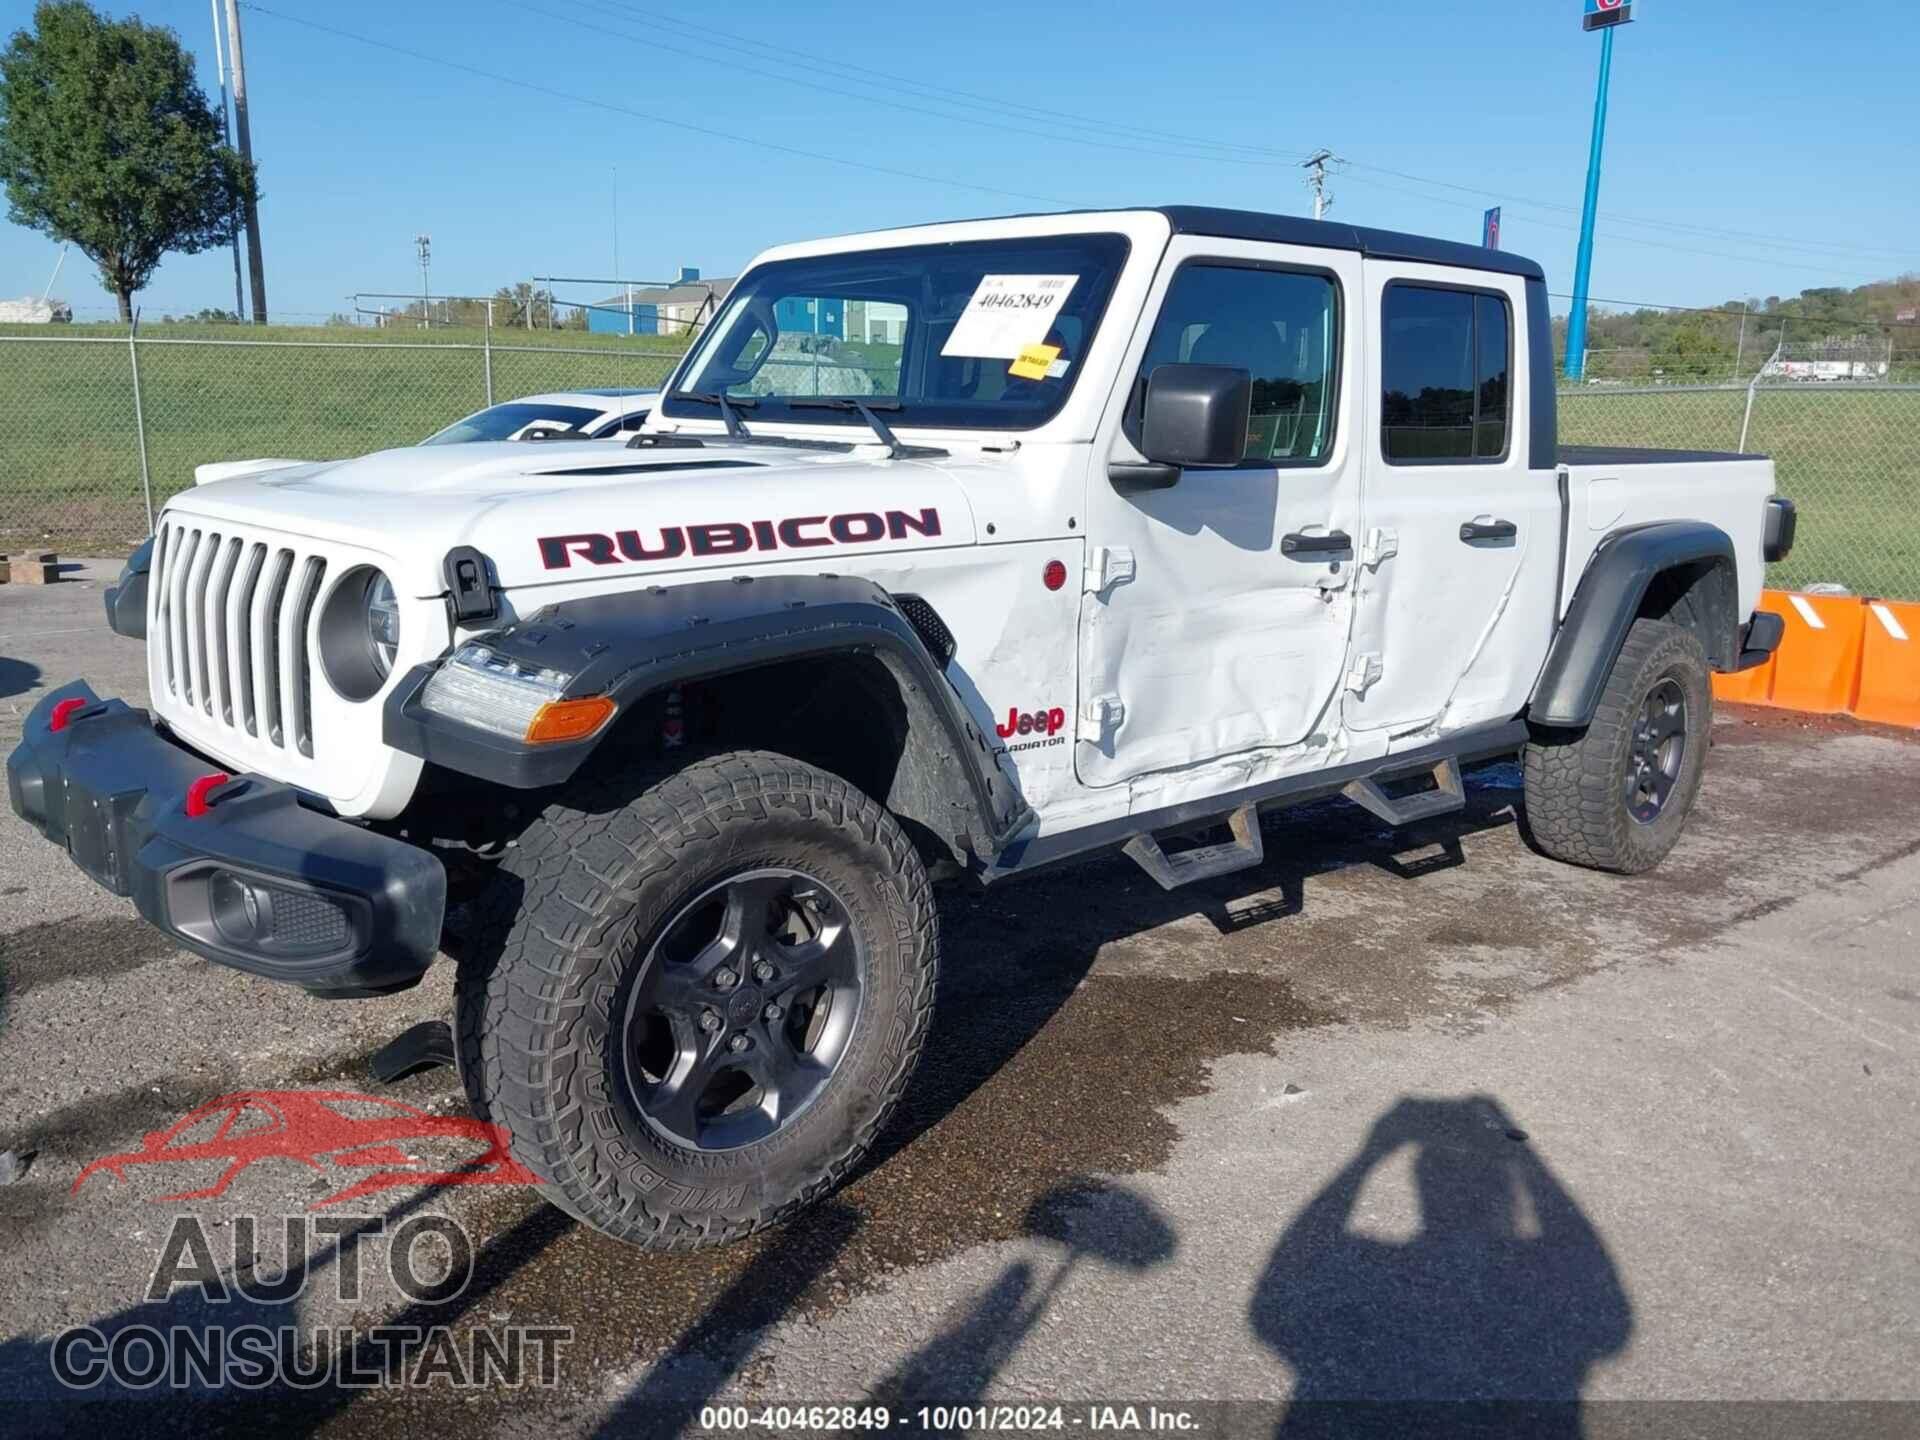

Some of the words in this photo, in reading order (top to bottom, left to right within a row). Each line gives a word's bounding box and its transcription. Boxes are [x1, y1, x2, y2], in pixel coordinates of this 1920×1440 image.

[978, 293, 1055, 309] 40462849
[537, 508, 941, 570] RUBICON
[996, 707, 1065, 738] Jeep
[583, 1023, 750, 1209] WILDPEAK
